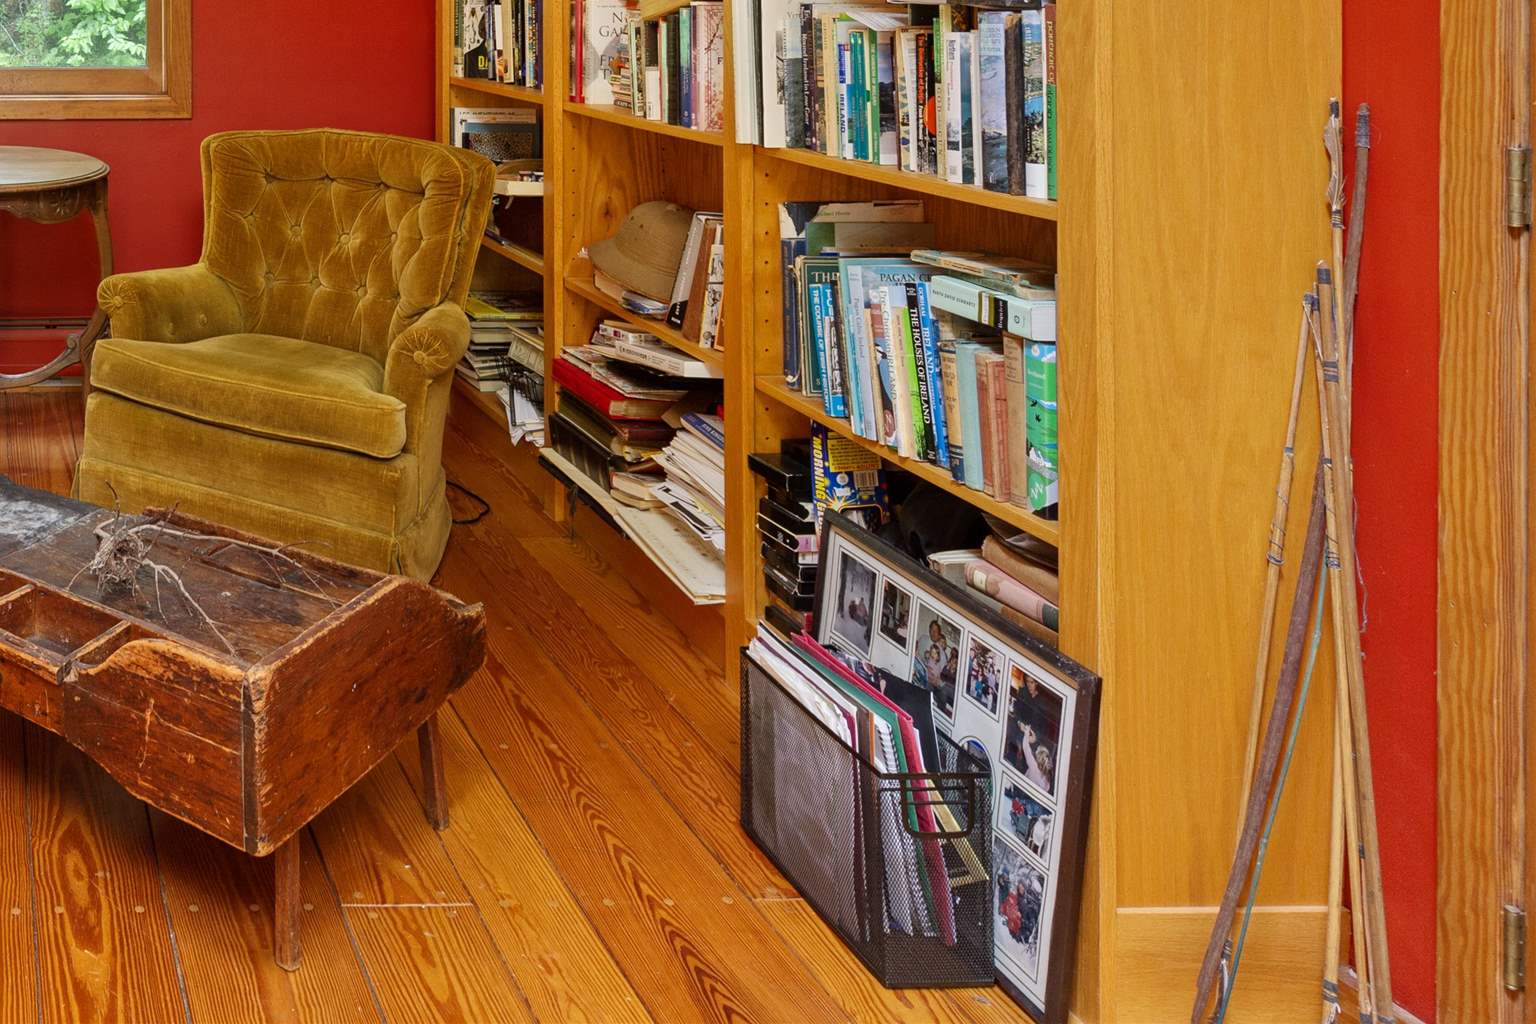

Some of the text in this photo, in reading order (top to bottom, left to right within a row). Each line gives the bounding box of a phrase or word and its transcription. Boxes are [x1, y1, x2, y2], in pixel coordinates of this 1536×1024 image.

[880, 273, 916, 282] PAGAN
[818, 339, 823, 350] OF
[910, 307, 930, 424] THE HOUSES OF IRELAND
[924, 327, 935, 373] IRELAND
[887, 355, 896, 401] IRELAND
[812, 436, 827, 500] MORNING
